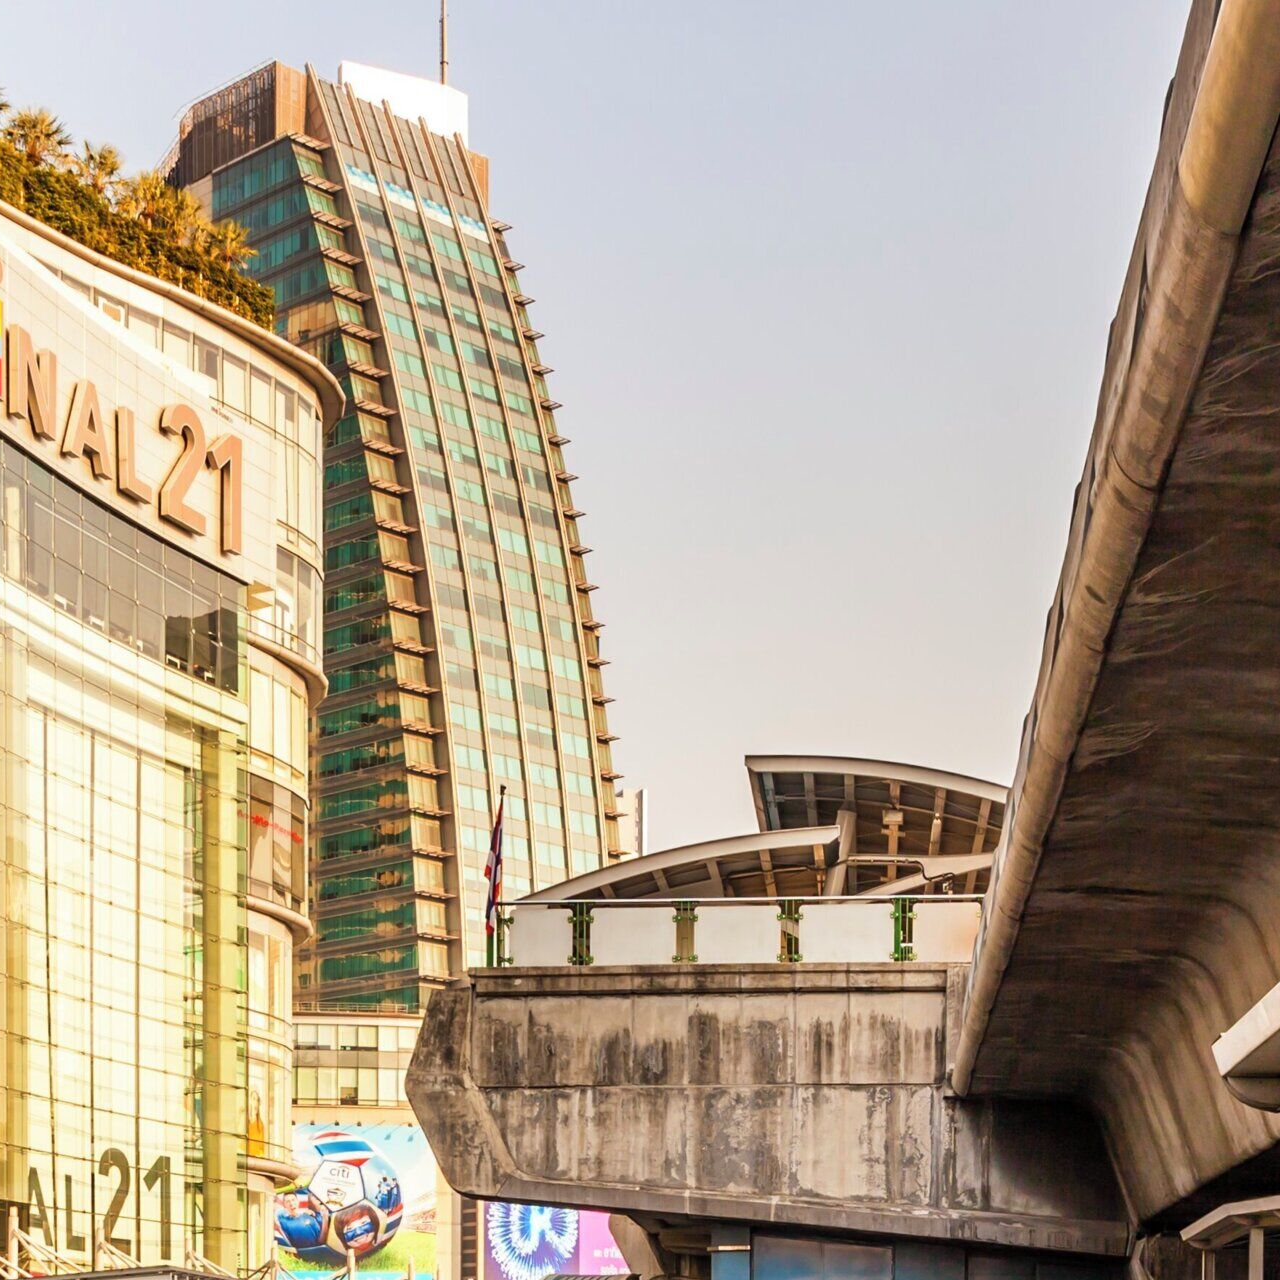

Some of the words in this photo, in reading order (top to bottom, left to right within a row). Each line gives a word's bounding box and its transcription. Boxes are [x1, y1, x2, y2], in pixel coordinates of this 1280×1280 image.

[159, 402, 243, 557] 21
[98, 1147, 172, 1263] 21
[329, 1166, 350, 1180] citi
